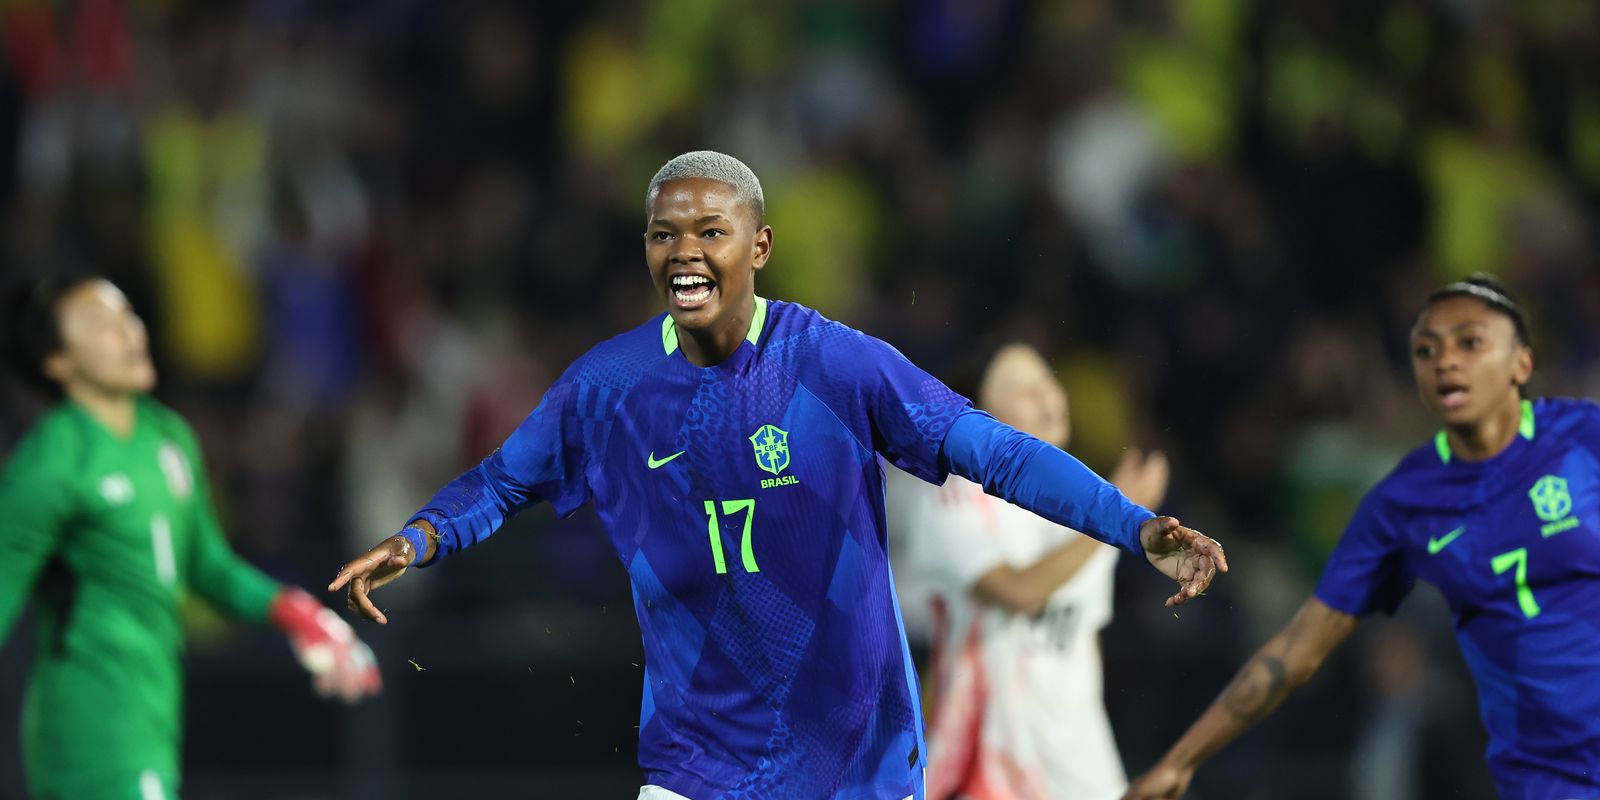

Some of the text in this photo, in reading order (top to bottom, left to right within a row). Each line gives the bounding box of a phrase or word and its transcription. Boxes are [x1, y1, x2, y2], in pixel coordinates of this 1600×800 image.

[764, 444, 778, 452] CBF
[761, 475, 800, 488] BRASIL
[704, 499, 760, 574] 17
[1491, 547, 1541, 618] 7
